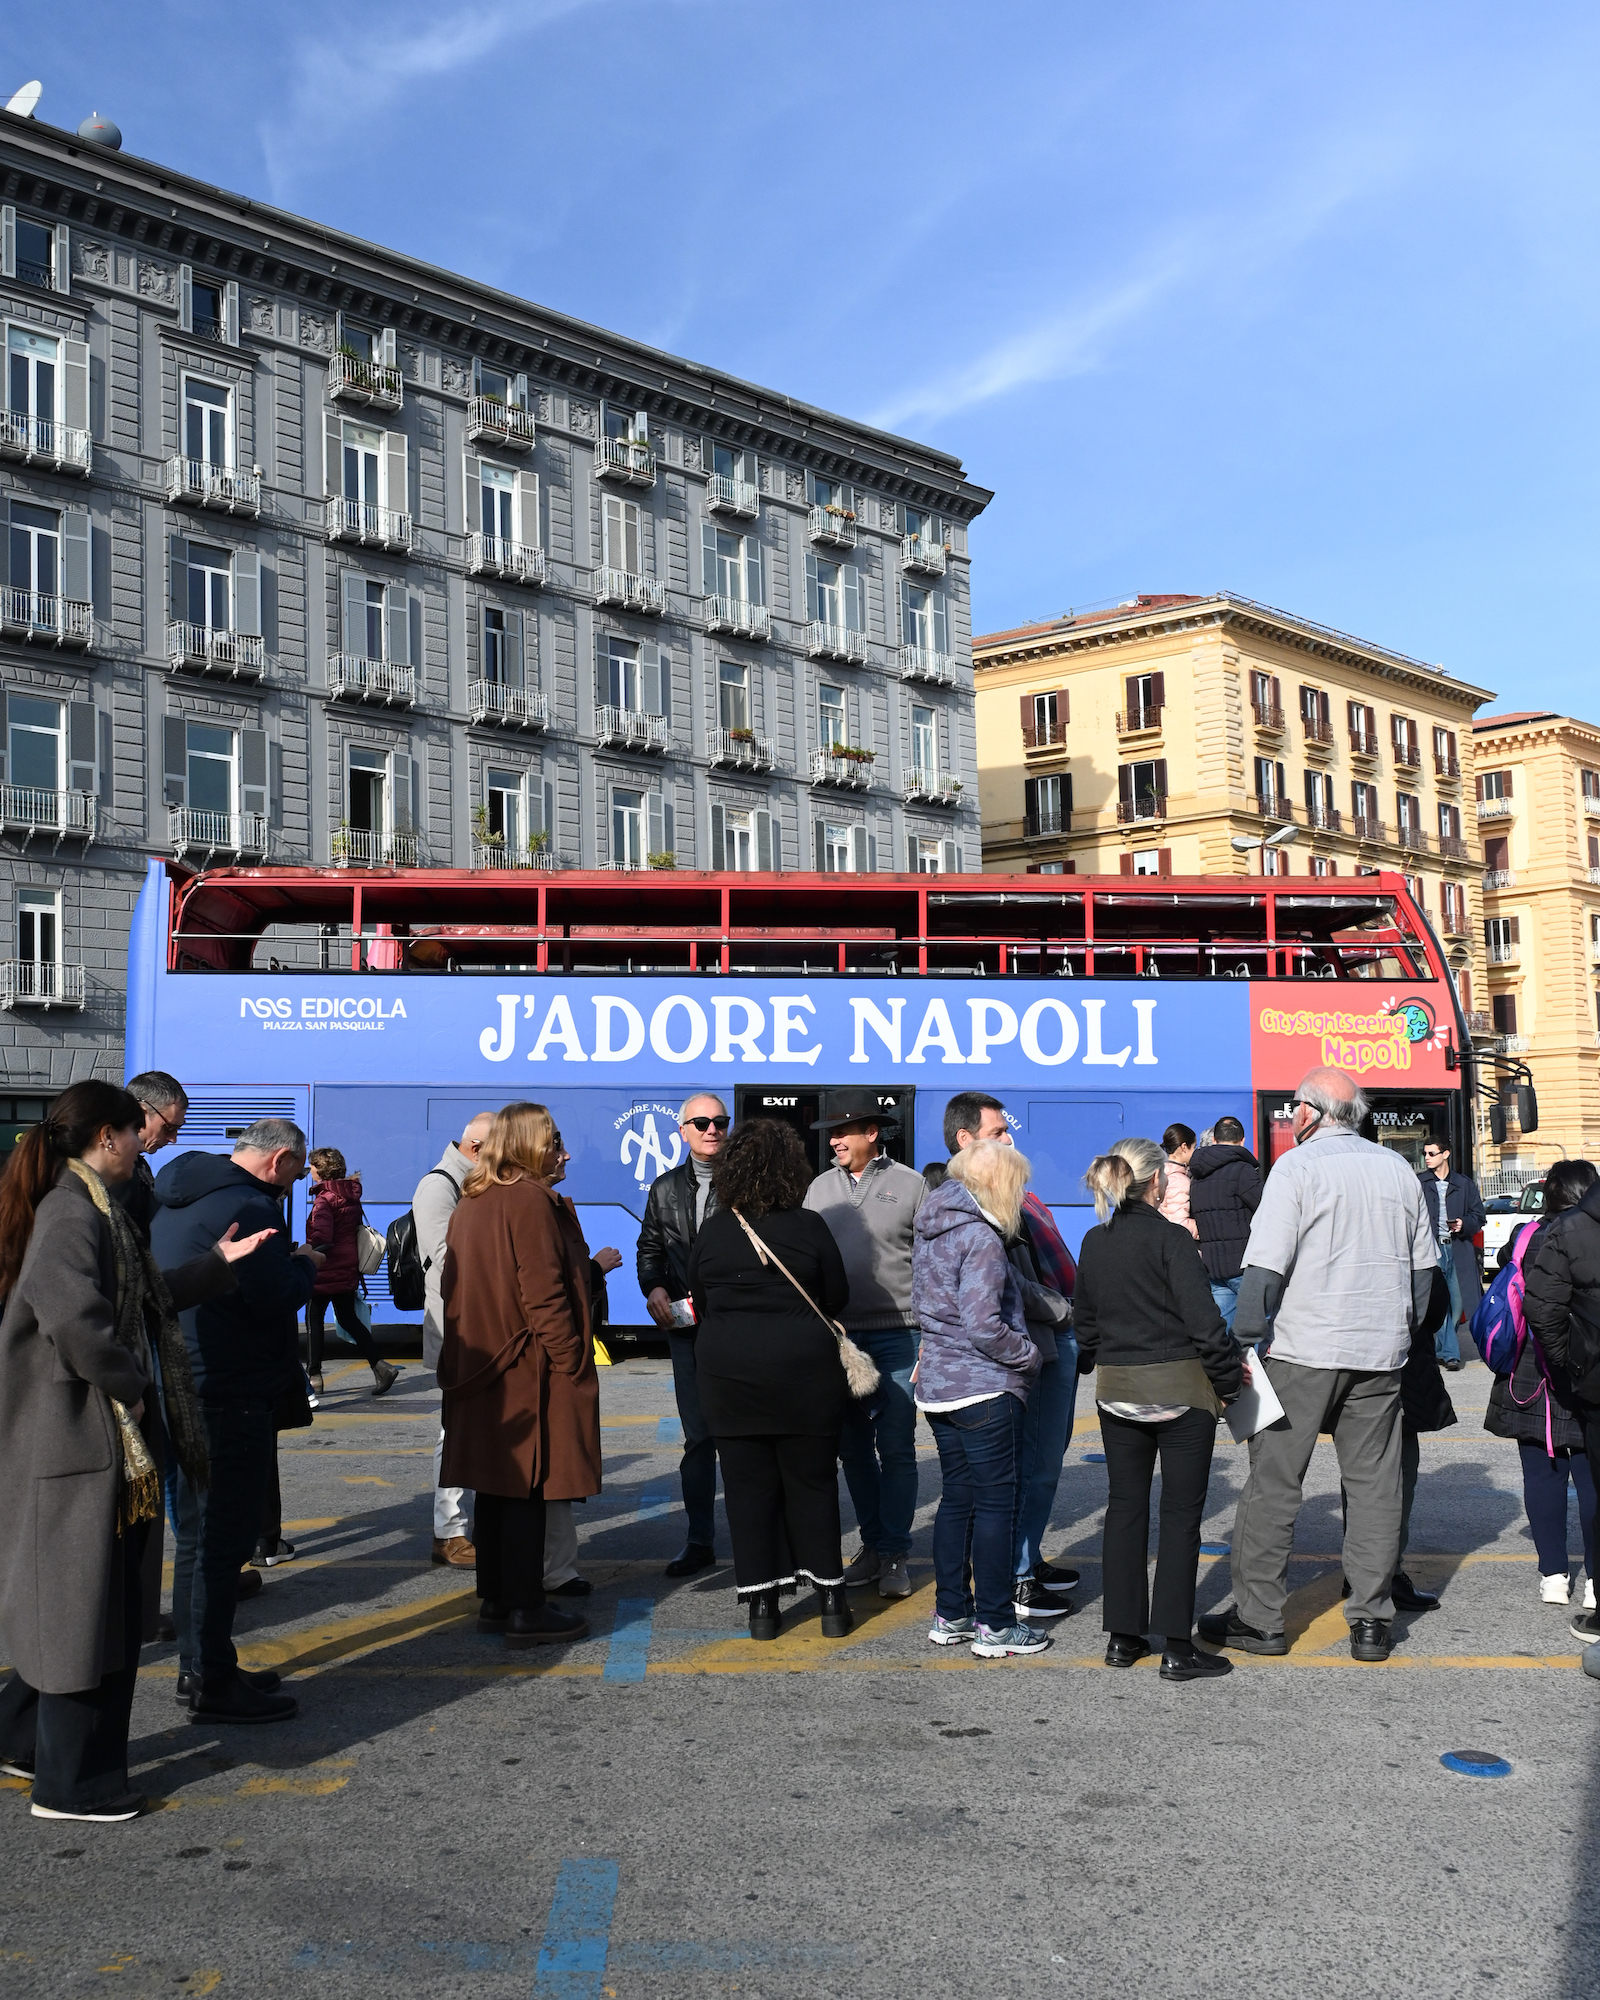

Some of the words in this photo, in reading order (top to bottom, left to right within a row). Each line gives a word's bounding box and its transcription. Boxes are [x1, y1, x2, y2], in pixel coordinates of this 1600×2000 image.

[301, 998, 408, 1018] EDICOLA
[263, 1021, 303, 1030] PIAZZA
[305, 1021, 327, 1030] SAN
[330, 1021, 385, 1031] PASQUALE
[479, 994, 823, 1067] J'ADORE
[849, 998, 1159, 1068] NAPOLI
[1323, 1036, 1410, 1072] Napoli
[763, 1097, 798, 1106] EXIT
[613, 1104, 650, 1130] J'ADORE
[652, 1104, 681, 1124] NAPO
[1001, 1110, 1022, 1130] POLI
[1370, 1112, 1425, 1120] NTRTA
